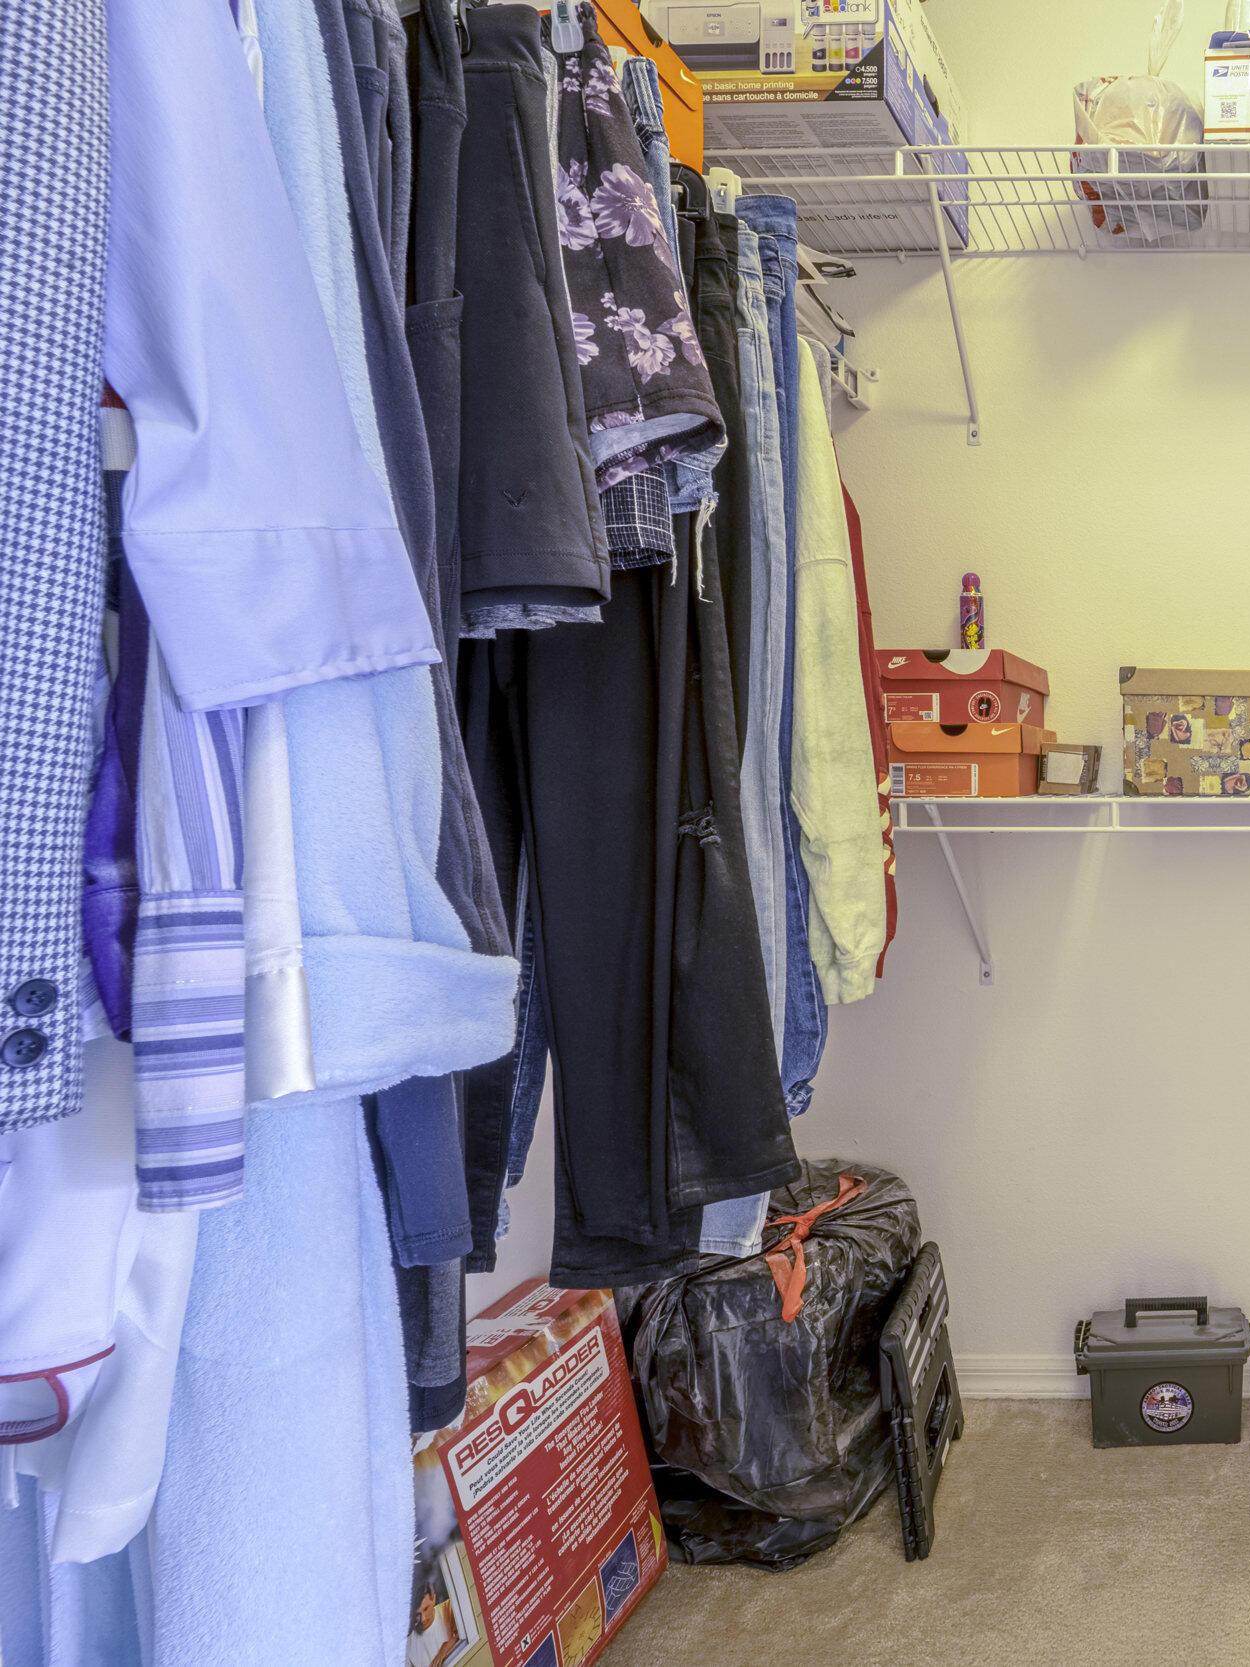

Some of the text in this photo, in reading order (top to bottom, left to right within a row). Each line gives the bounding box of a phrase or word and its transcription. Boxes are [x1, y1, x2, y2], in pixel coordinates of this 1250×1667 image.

[713, 91, 818, 101] sans cartouche à domicile
[715, 82, 735, 90] basic
[763, 82, 794, 92] printing
[487, 1447, 502, 1465] Could
[504, 1434, 516, 1450] Save
[519, 1423, 529, 1436] Your
[531, 1413, 539, 1425] Life
[542, 1401, 553, 1415] When
[556, 1383, 573, 1402] Seconds
[495, 1454, 515, 1477] salvarle
[523, 1437, 533, 1450] vida
[535, 1420, 551, 1439] cuando
[553, 1409, 563, 1422] cada
[565, 1390, 582, 1411] segundo
[545, 1391, 602, 1452] The Emergency Fire Ladder
[469, 1474, 482, 1490] Peut
[484, 1462, 496, 1477] vous
[499, 1444, 516, 1463] sauver
[533, 1413, 549, 1433] lorsque
[560, 1385, 578, 1407] secondes
[556, 1437, 566, 1451] That
[563, 1442, 571, 1455] Any
[573, 1425, 589, 1445] Window
[560, 1449, 576, 1469] Instant
[577, 1439, 585, 1452] Fire
